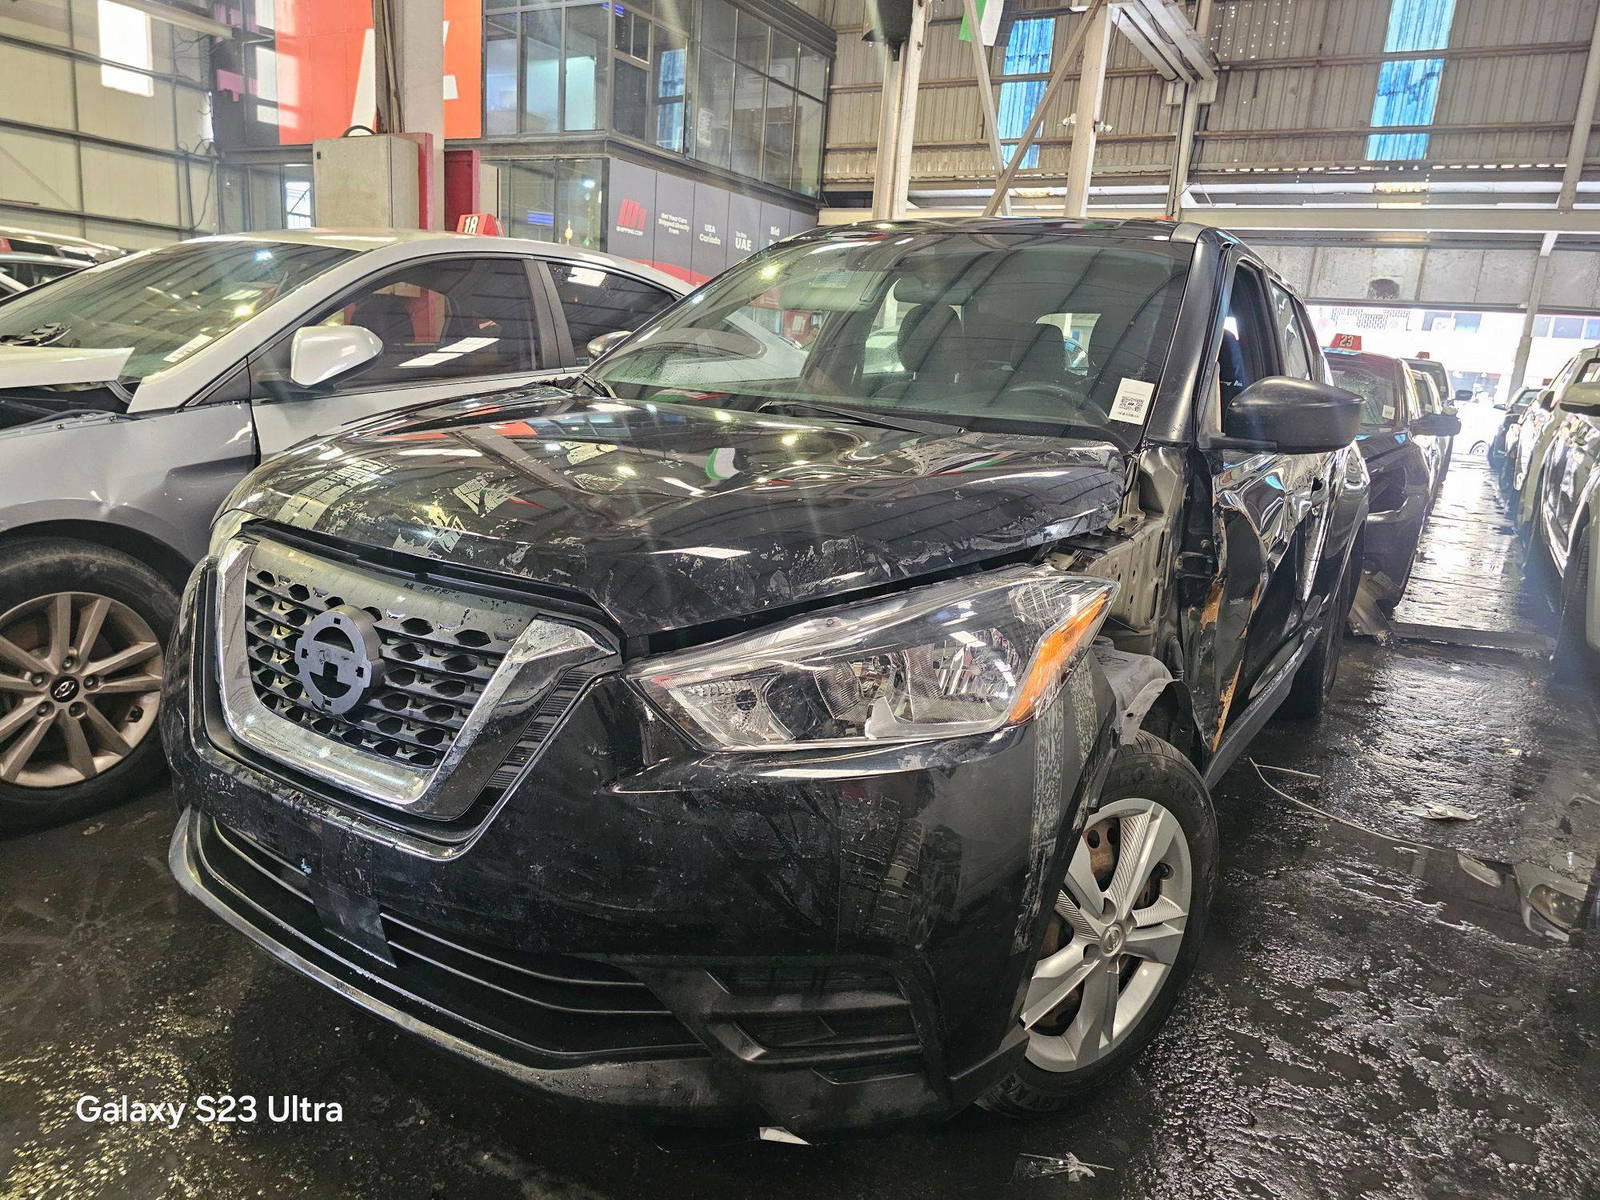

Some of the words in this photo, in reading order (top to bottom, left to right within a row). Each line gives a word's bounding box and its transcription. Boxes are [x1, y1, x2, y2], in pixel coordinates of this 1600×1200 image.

[464, 215, 479, 234] 18
[704, 223, 716, 234] USA
[699, 233, 721, 246] Canada
[735, 237, 752, 252] UAE
[1340, 335, 1353, 347] 23
